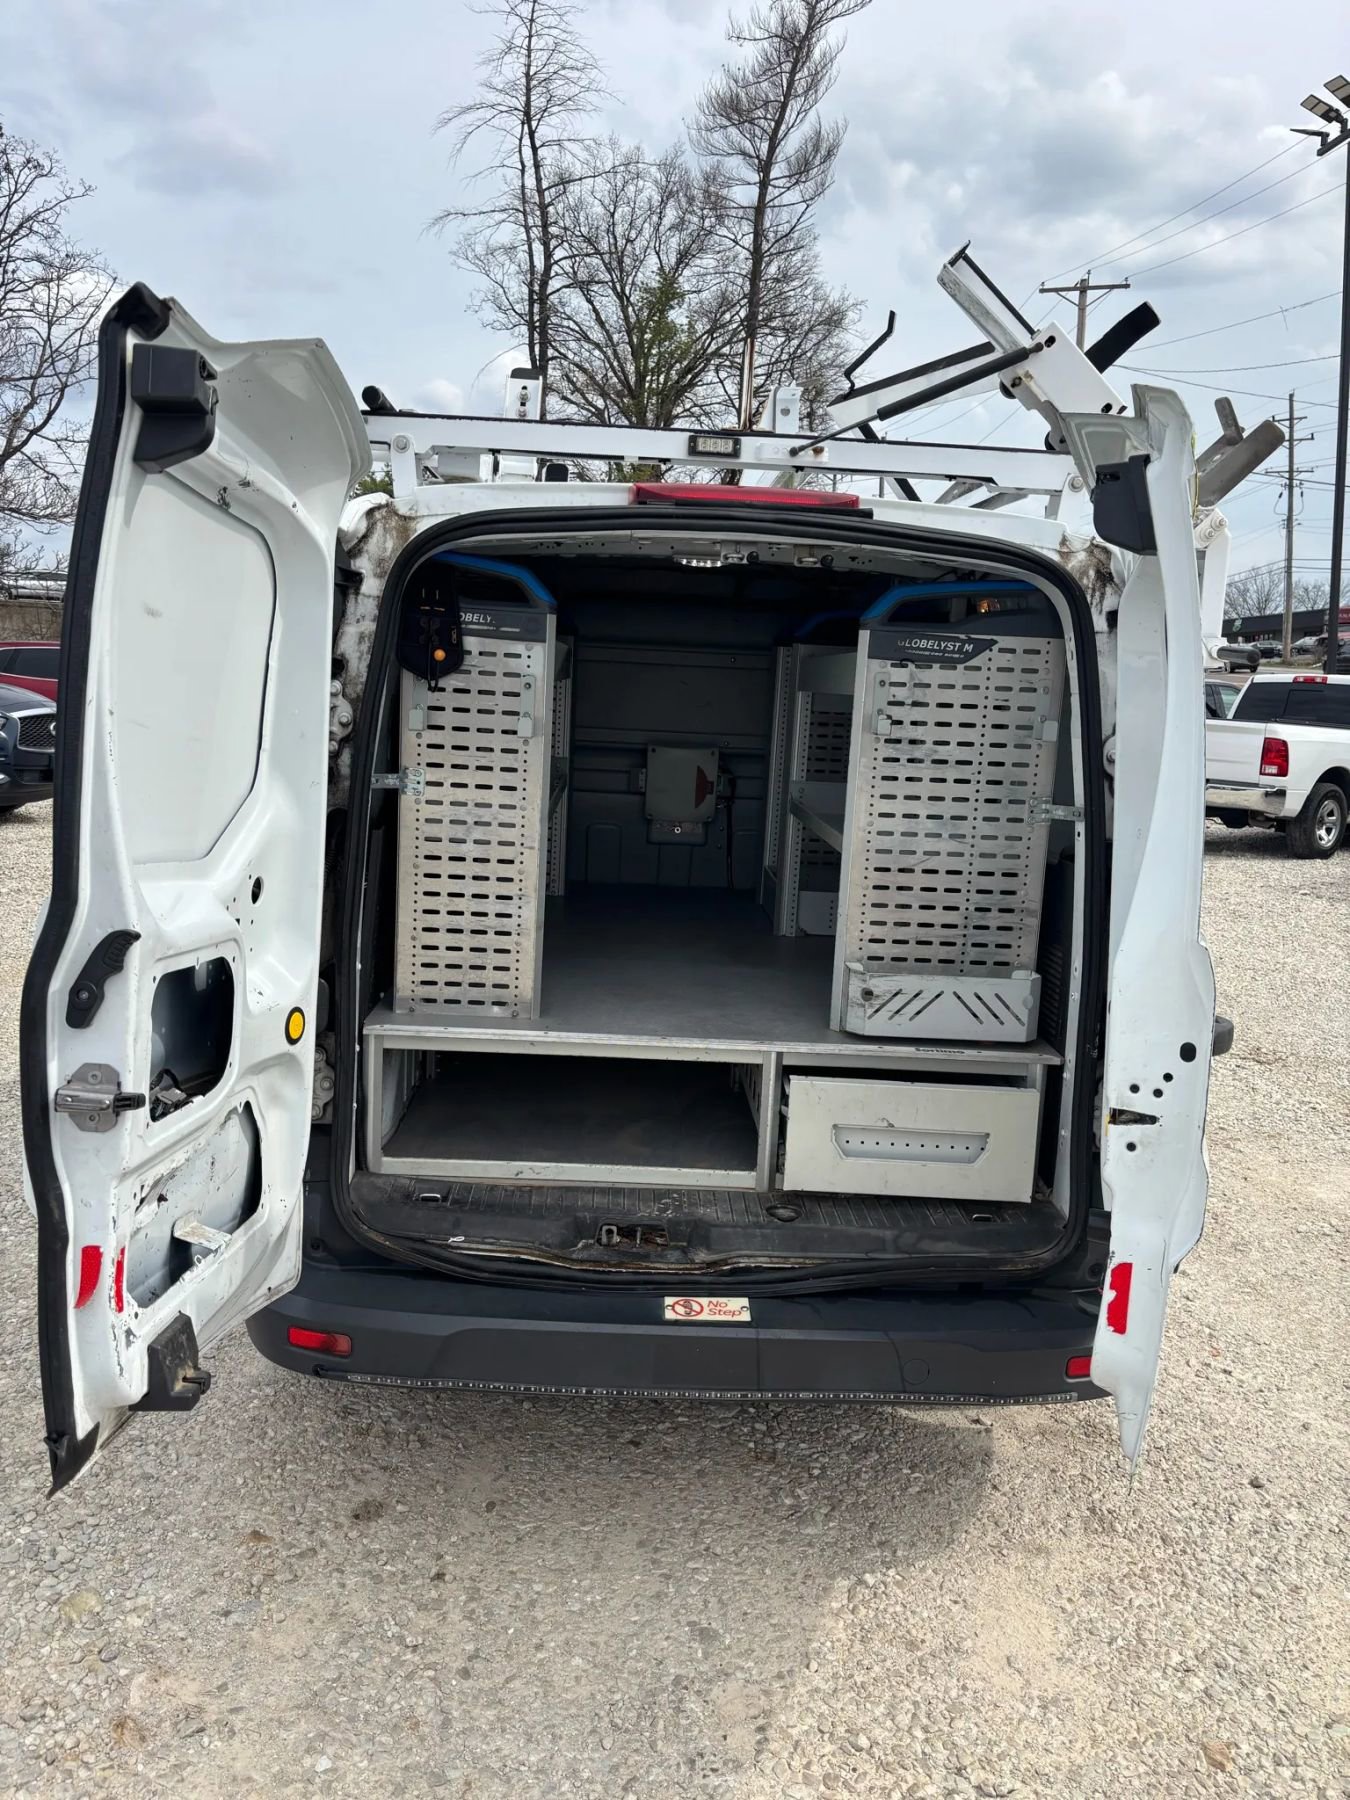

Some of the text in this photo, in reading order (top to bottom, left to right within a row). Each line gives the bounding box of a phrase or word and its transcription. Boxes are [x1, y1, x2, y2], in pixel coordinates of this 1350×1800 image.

[963, 643, 974, 653] M
[707, 1300, 728, 1308] No
[707, 1308, 742, 1317] Step
